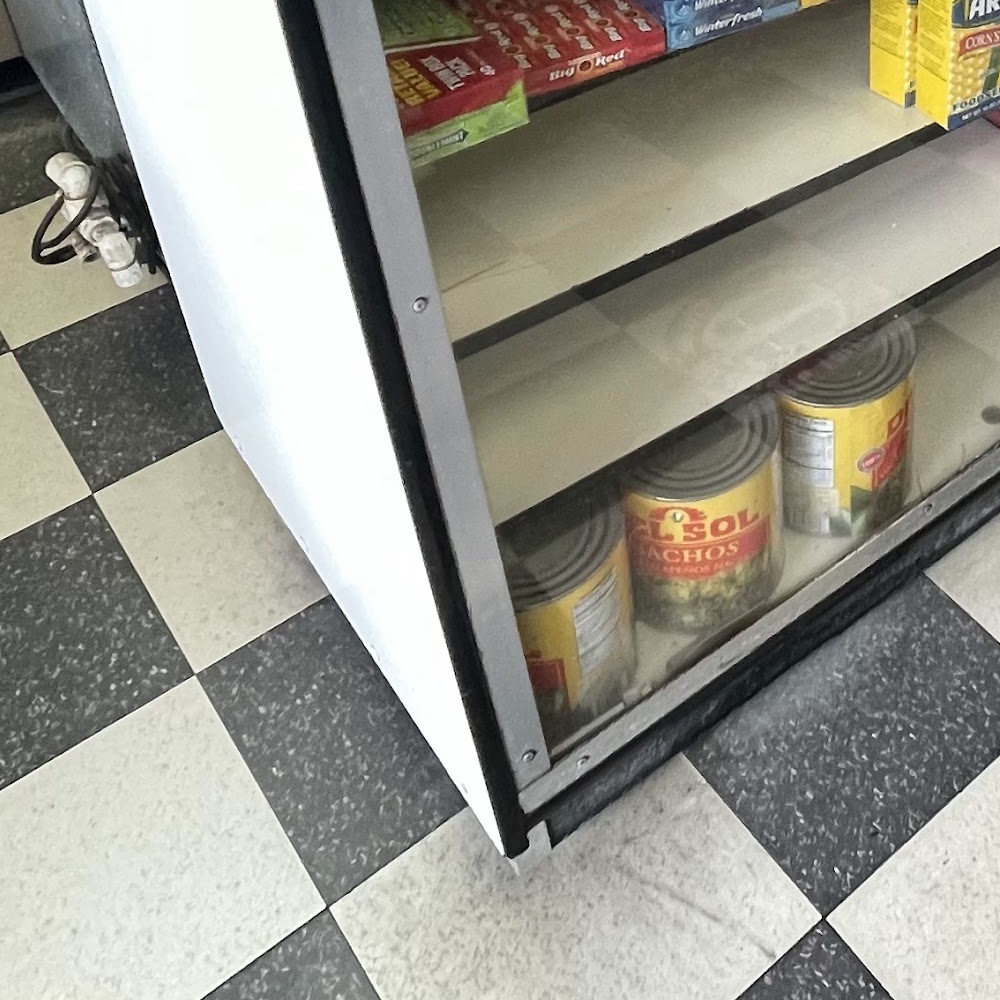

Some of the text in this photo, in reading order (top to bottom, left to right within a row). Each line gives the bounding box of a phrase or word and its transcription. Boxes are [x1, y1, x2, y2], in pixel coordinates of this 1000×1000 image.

[695, 6, 763, 37] Winterfresh
[965, 31, 993, 50] CORN
[549, 49, 626, 82] Big Red
[683, 508, 761, 542] SOL
